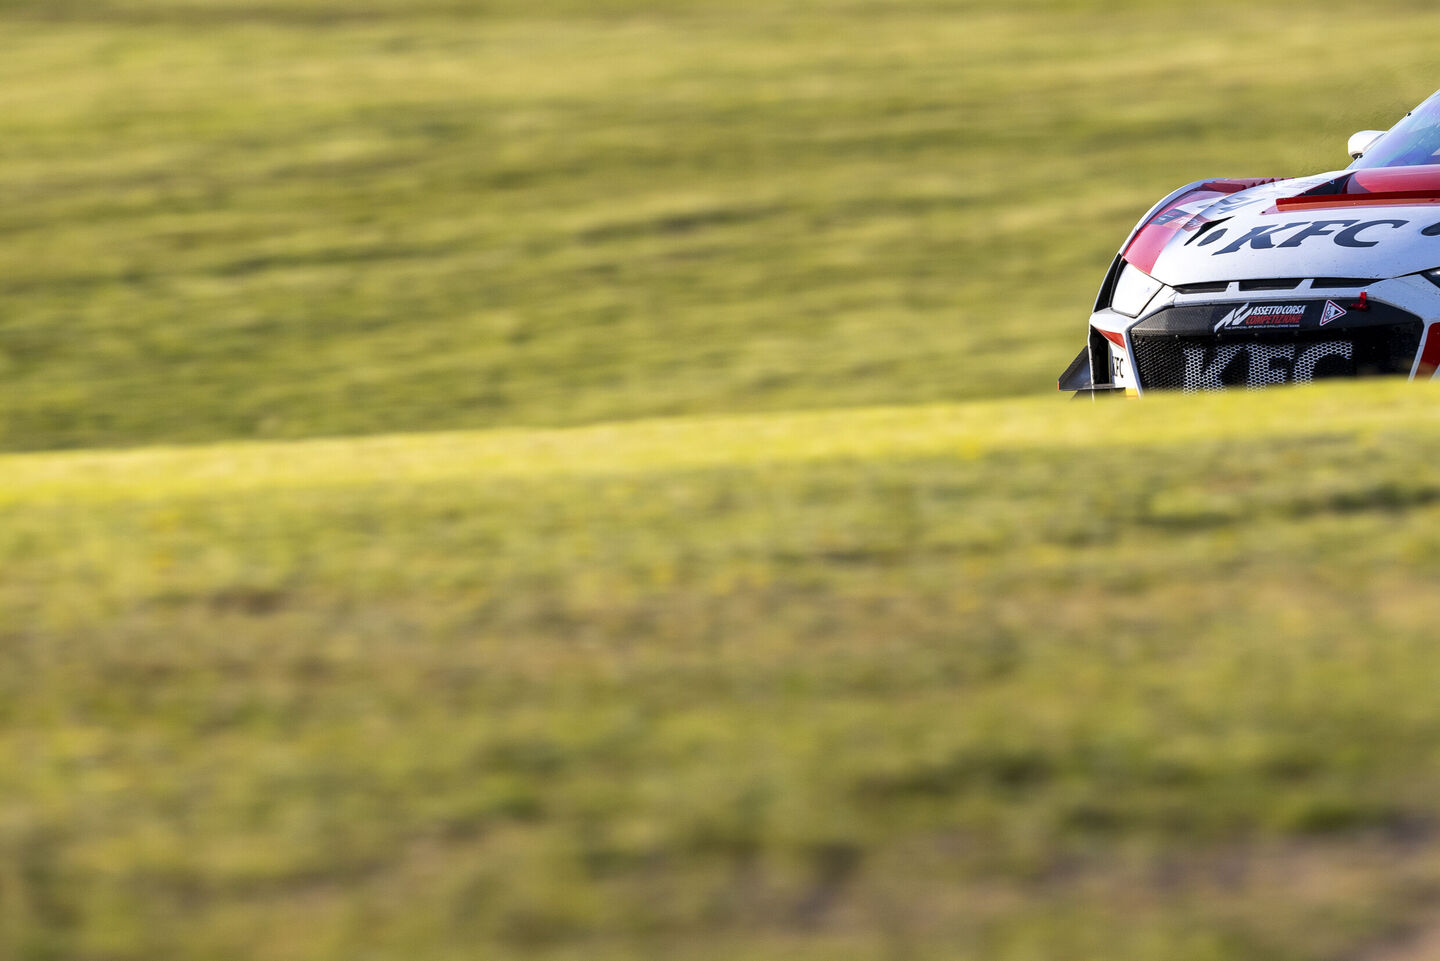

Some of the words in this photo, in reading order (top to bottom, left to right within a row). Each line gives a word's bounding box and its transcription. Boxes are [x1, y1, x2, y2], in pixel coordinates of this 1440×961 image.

[1211, 219, 1409, 256] KFC
[1251, 305, 1282, 315] ASSETTO
[1281, 305, 1306, 314] CORSA
[1245, 314, 1303, 325] COMPETIZIONE
